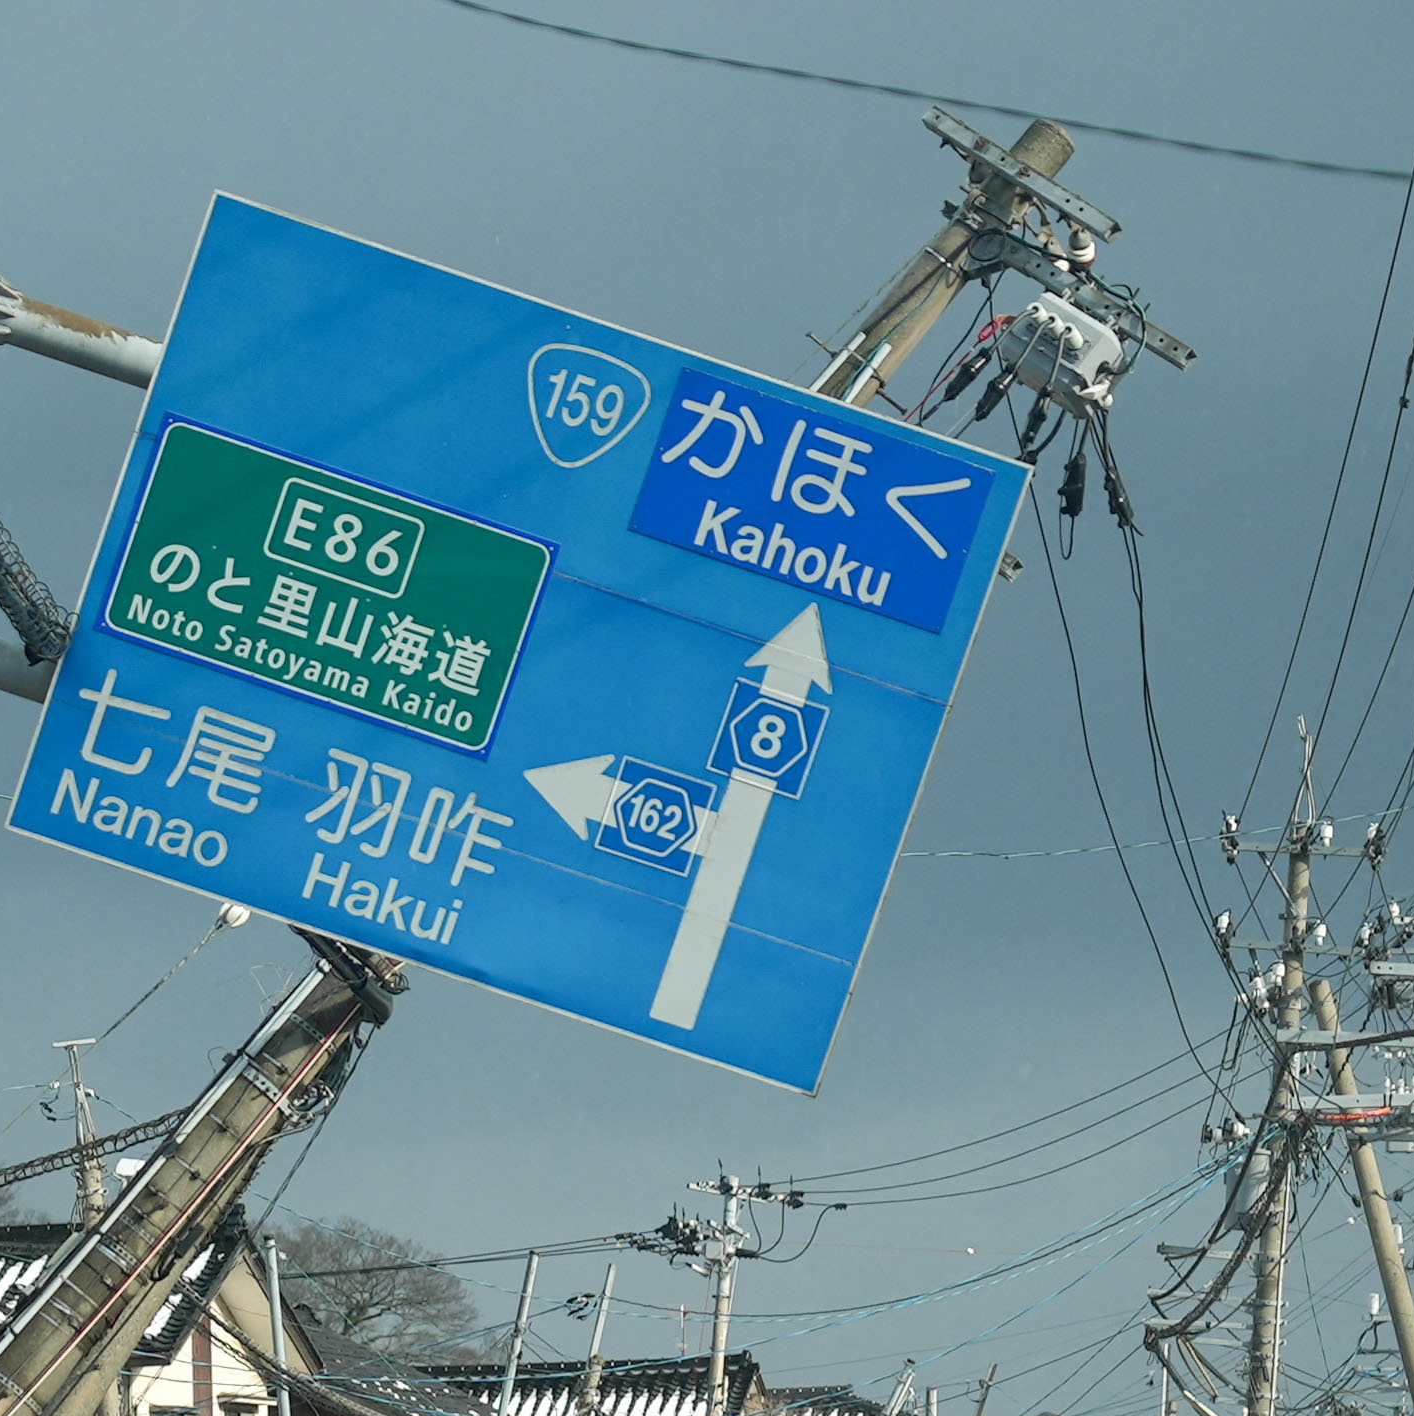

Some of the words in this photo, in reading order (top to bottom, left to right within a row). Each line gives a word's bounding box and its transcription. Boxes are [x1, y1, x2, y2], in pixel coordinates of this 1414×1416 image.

[546, 366, 626, 437] 159
[659, 388, 973, 561] かほく
[281, 496, 401, 579] E86
[692, 498, 891, 608] Kahoku
[126, 594, 204, 644] Noto
[213, 622, 370, 703] Satoyama
[380, 670, 474, 733] Kaido
[148, 542, 492, 697] のと里山海道
[76, 668, 277, 816] 七尾
[306, 747, 515, 888] 羽咋
[752, 712, 784, 762] 8
[50, 766, 229, 869] Nanao
[301, 852, 465, 946] Hakui
[628, 794, 683, 840] 162
